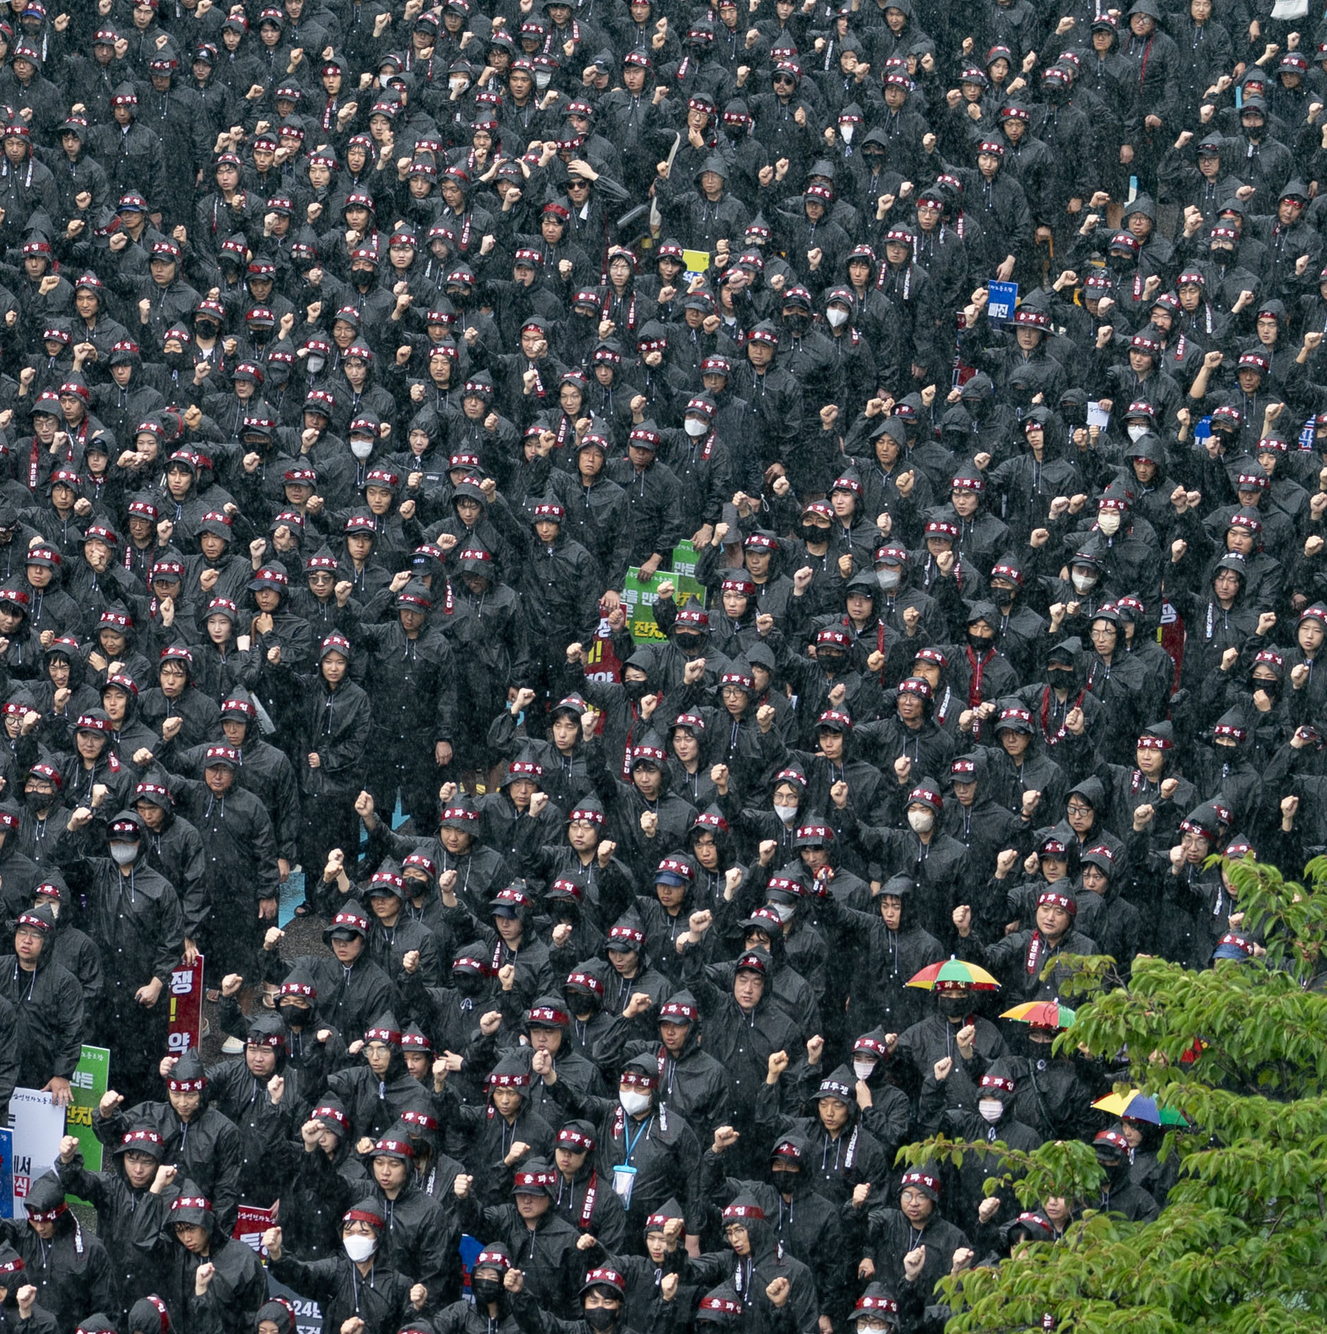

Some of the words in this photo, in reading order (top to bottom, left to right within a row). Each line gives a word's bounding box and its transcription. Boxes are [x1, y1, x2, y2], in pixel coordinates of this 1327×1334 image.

[1028, 940, 1039, 967] NSEU
[172, 1198, 204, 1209] 파업
[584, 1189, 595, 1220] NSEU
